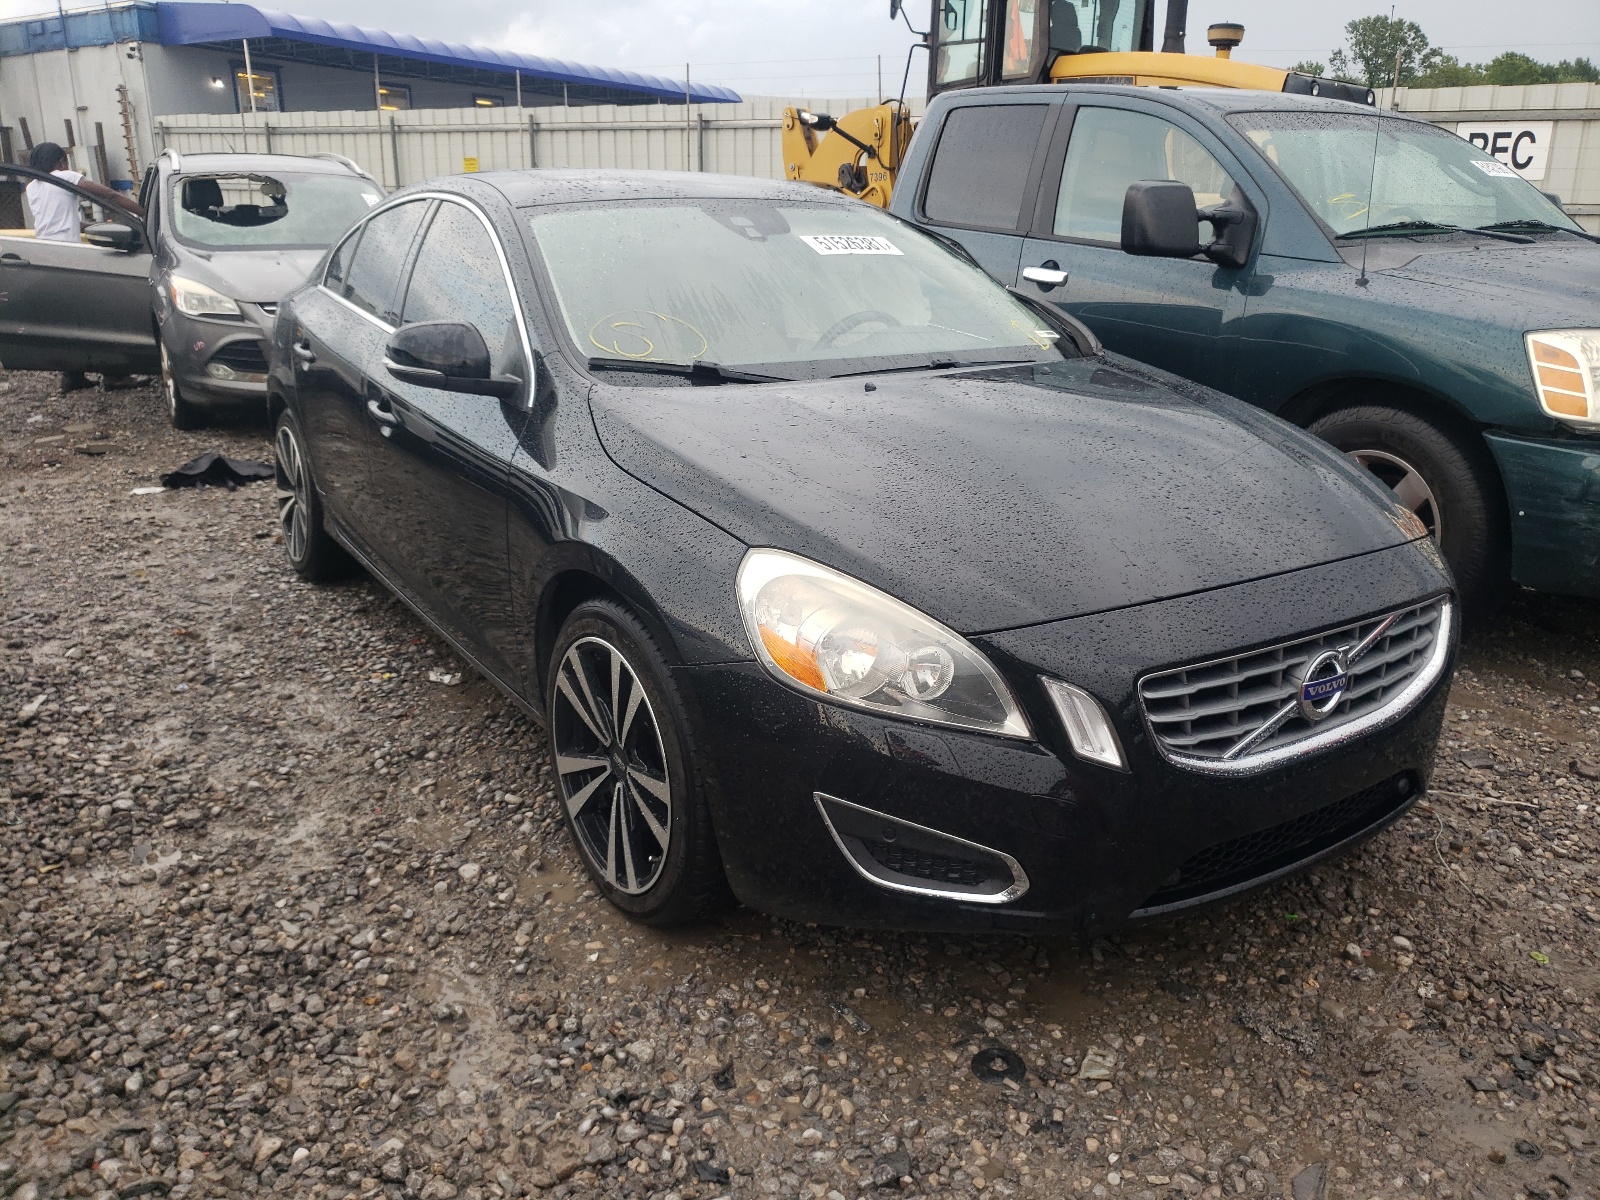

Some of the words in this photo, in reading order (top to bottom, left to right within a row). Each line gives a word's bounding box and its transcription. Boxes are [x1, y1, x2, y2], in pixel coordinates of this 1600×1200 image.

[870, 172, 887, 182] 7396
[813, 237, 887, 250] 51526381
[1308, 678, 1345, 696] VOLVO
